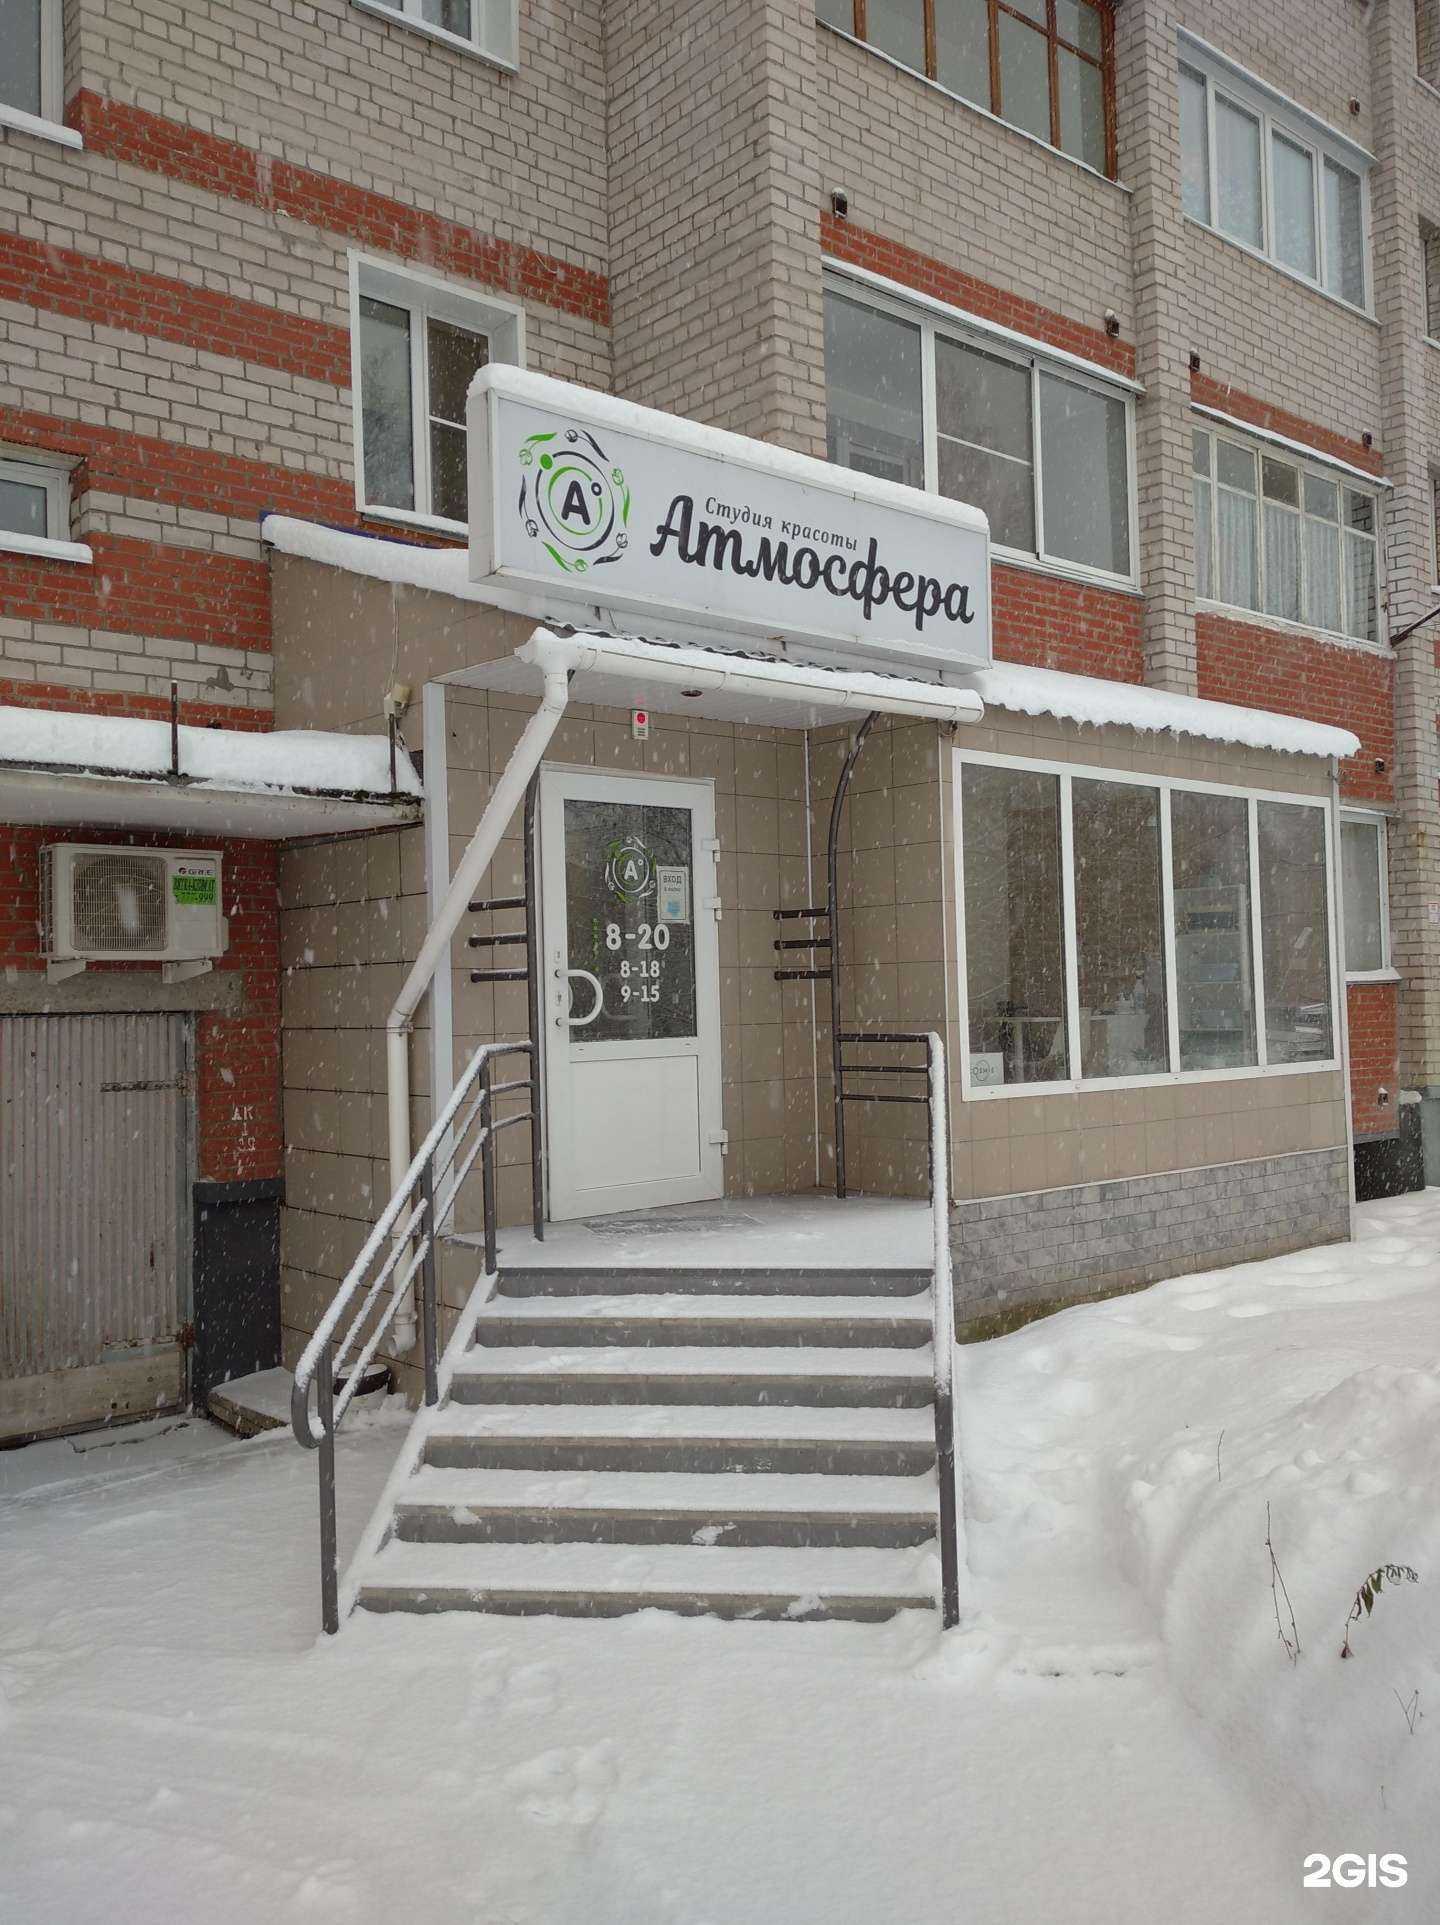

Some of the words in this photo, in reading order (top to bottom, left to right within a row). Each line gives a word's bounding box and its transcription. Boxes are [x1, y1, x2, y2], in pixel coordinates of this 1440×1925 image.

[705, 496, 773, 530] Студия
[781, 519, 858, 551] красоты
[649, 494, 974, 631] Атмосфера
[606, 923, 670, 951] 8-20
[620, 960, 660, 978] 8-18
[620, 985, 660, 1003] 9-15
